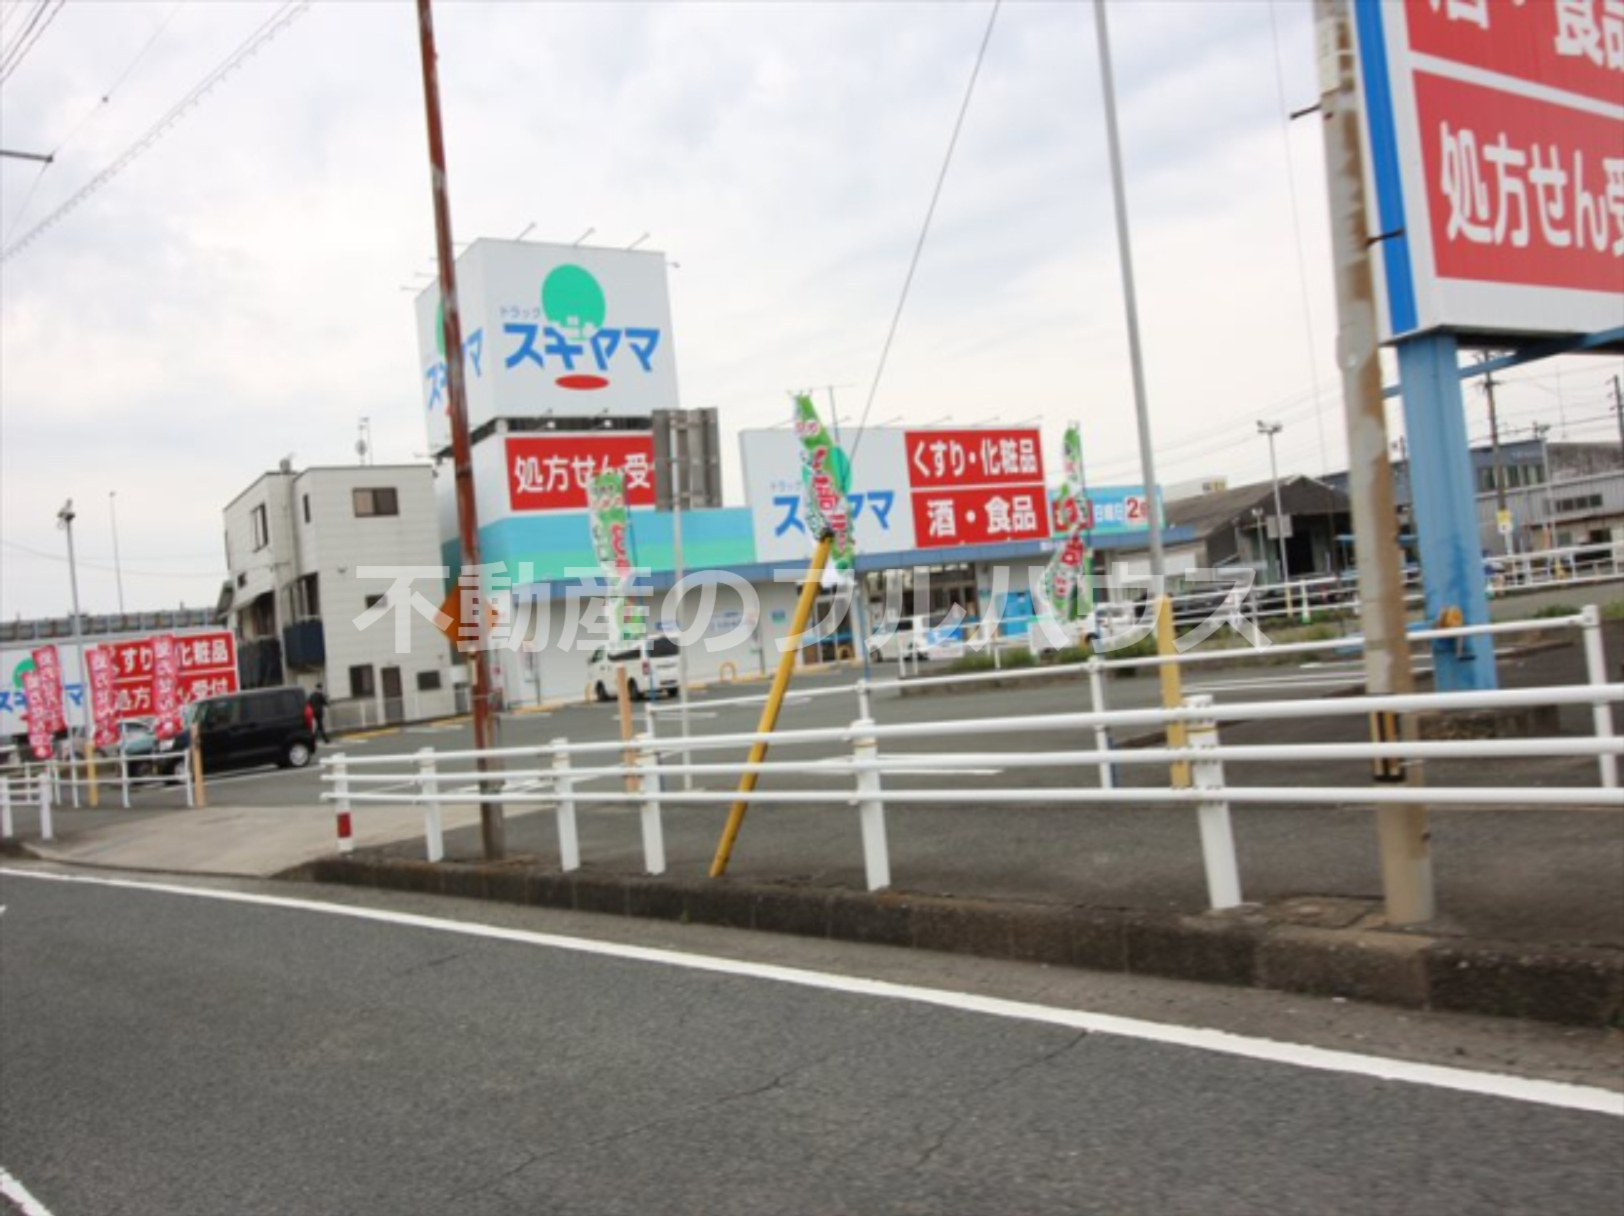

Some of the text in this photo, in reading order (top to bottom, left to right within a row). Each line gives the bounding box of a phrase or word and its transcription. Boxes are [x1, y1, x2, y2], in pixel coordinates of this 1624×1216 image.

[515, 453, 654, 493] 処方せん受
[913, 438, 1038, 478] くすり・化粧品
[927, 495, 1038, 538] 酒・食品
